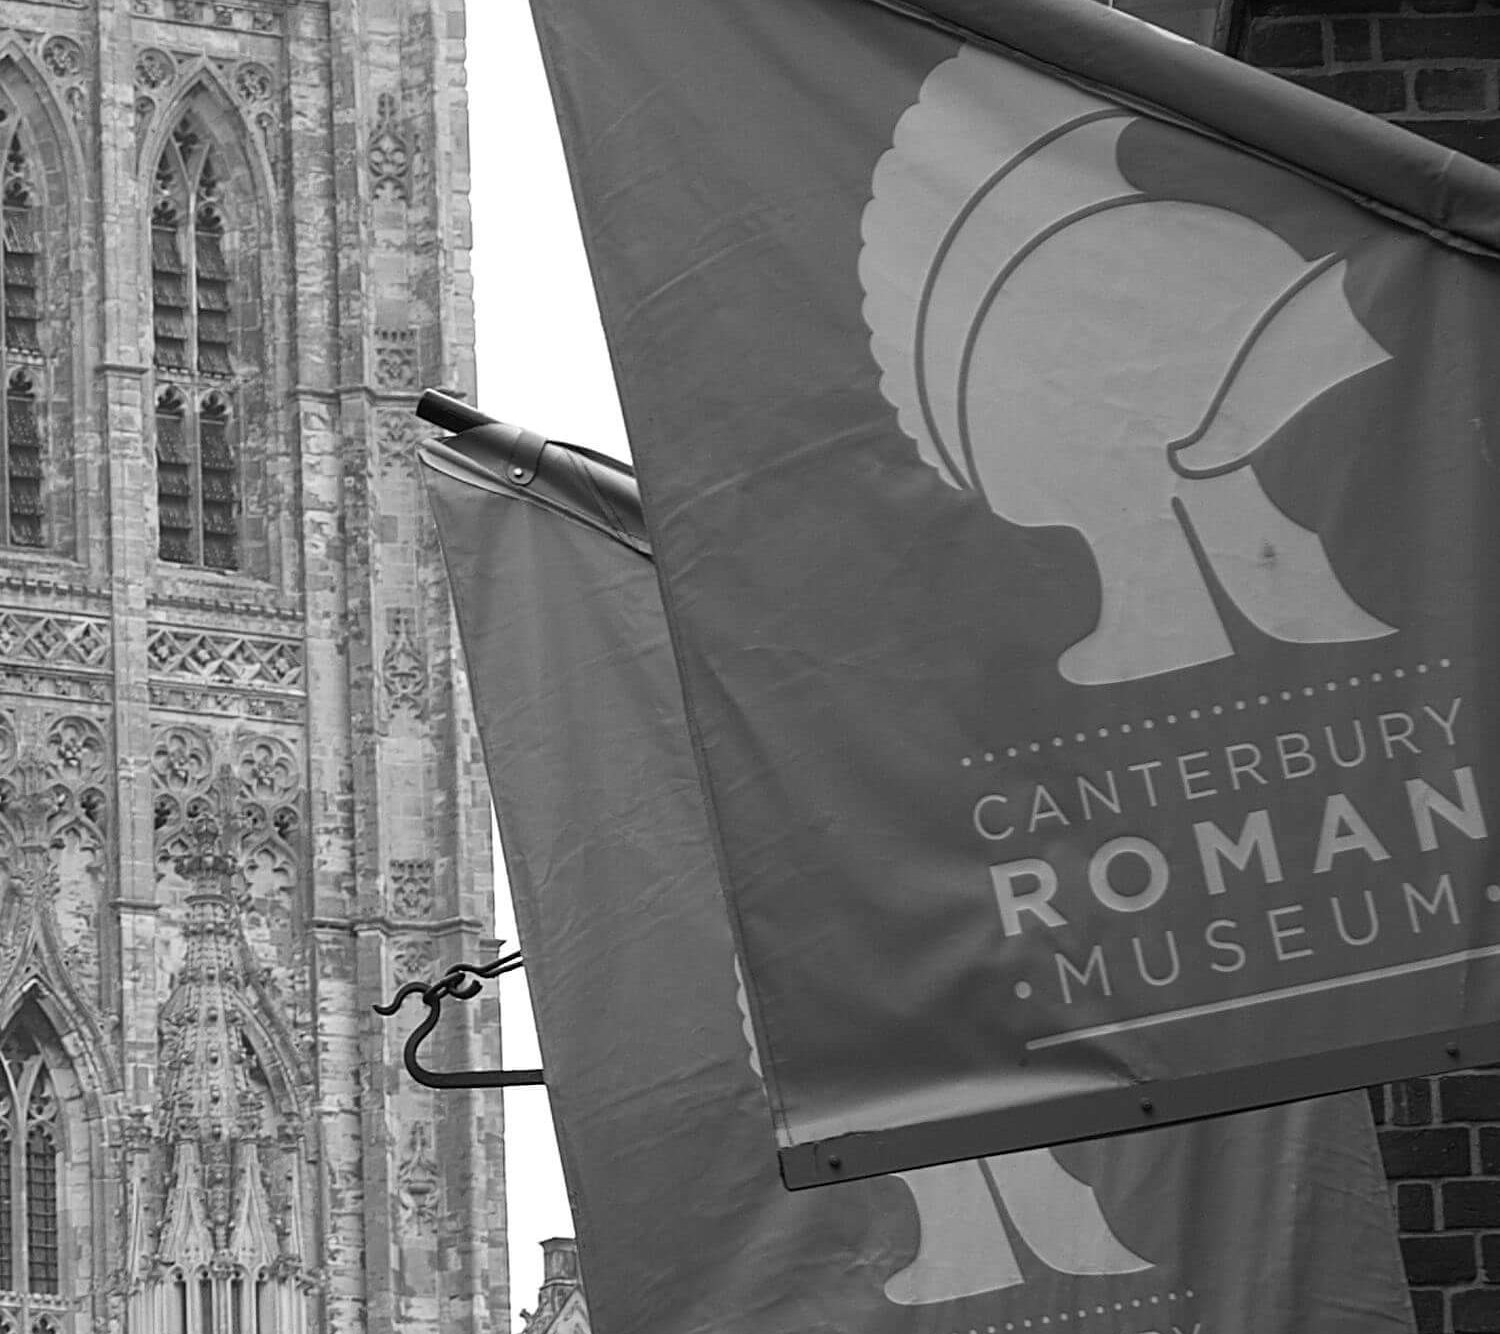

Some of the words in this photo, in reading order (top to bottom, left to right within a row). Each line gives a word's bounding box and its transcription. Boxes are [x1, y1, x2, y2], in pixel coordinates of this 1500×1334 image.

[971, 697, 1466, 842] CANTERBURY
[987, 765, 1491, 940] ROMAN
[1058, 875, 1464, 1006] MUSEUM
